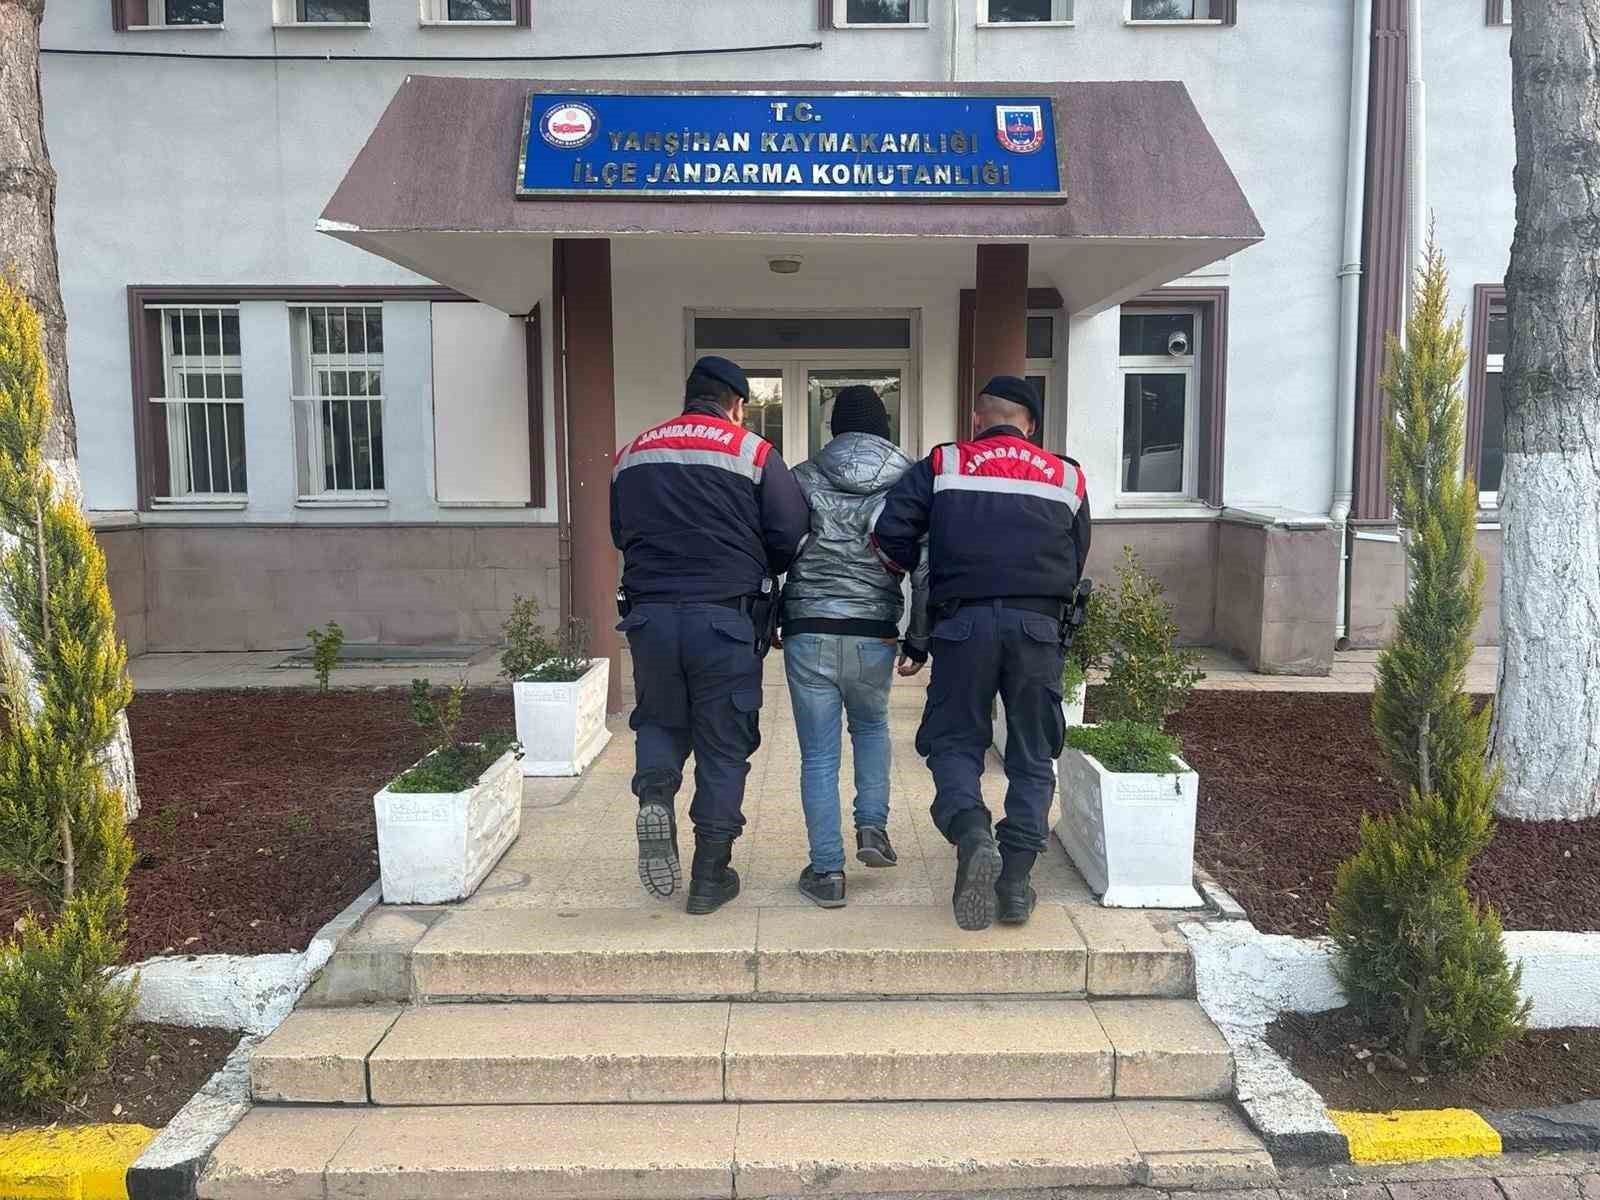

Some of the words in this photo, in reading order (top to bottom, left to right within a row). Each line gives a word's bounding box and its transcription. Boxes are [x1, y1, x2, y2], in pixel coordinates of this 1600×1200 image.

[771, 102, 823, 122] T.C.
[608, 127, 750, 157] YAHŞİHAN
[761, 129, 979, 154] KAYMAKAMLIĞI
[572, 157, 637, 187] İLÇE
[646, 162, 803, 185] JANDARMA
[812, 159, 1012, 186] KOMUTANLIĞI
[638, 423, 735, 446] JANDARMA
[965, 446, 1056, 480] JANDARMA
